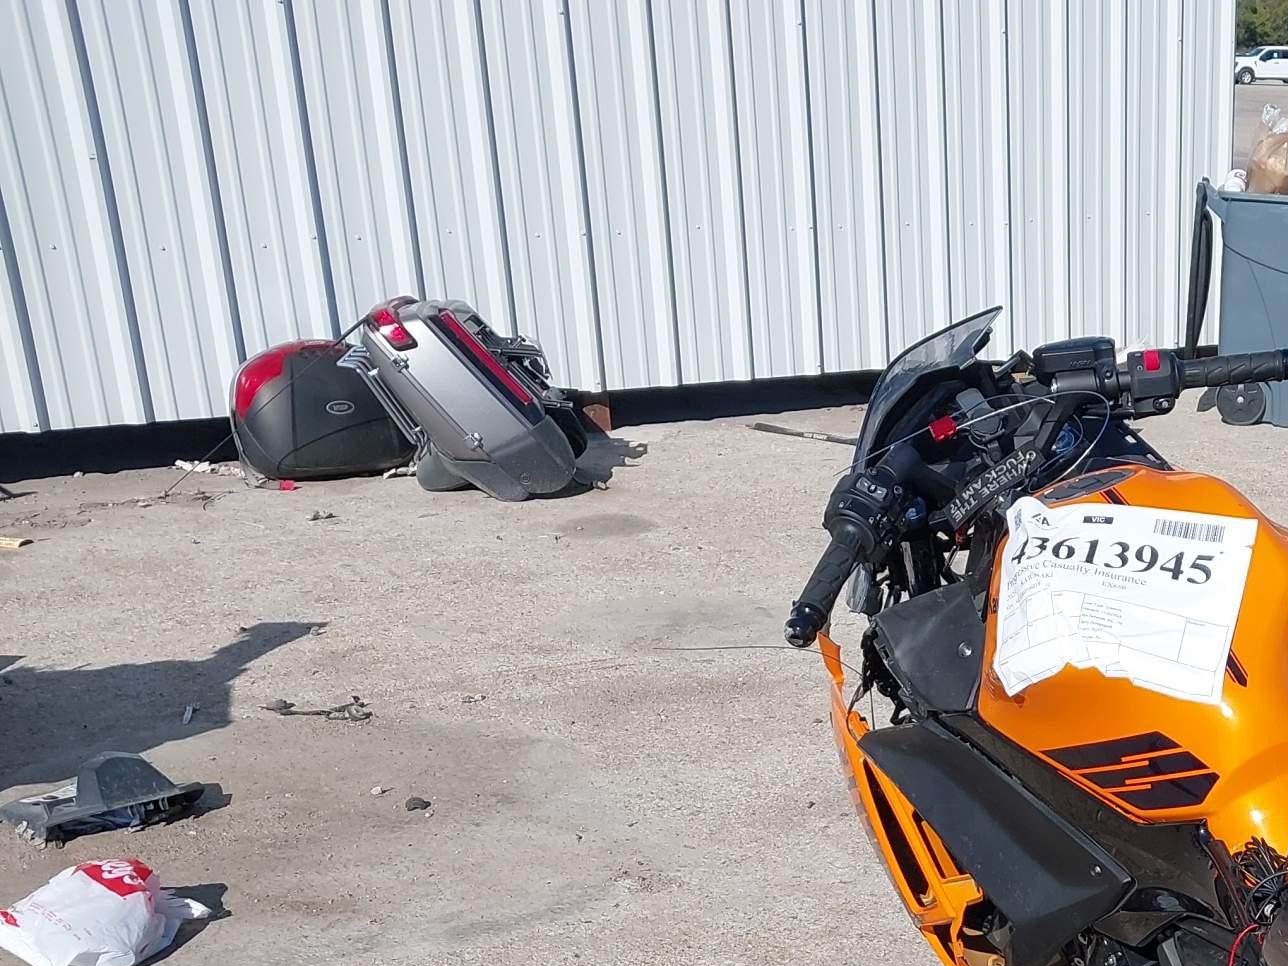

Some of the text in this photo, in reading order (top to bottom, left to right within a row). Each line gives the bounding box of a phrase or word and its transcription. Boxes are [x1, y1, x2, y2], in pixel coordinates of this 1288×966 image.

[985, 450, 1025, 483] FUCK
[952, 462, 1028, 522] WHERE THE
[962, 478, 982, 500] AM
[1010, 535, 1217, 586] 43613945
[1042, 559, 1090, 575] Casualty
[1094, 567, 1148, 587] Insurance
